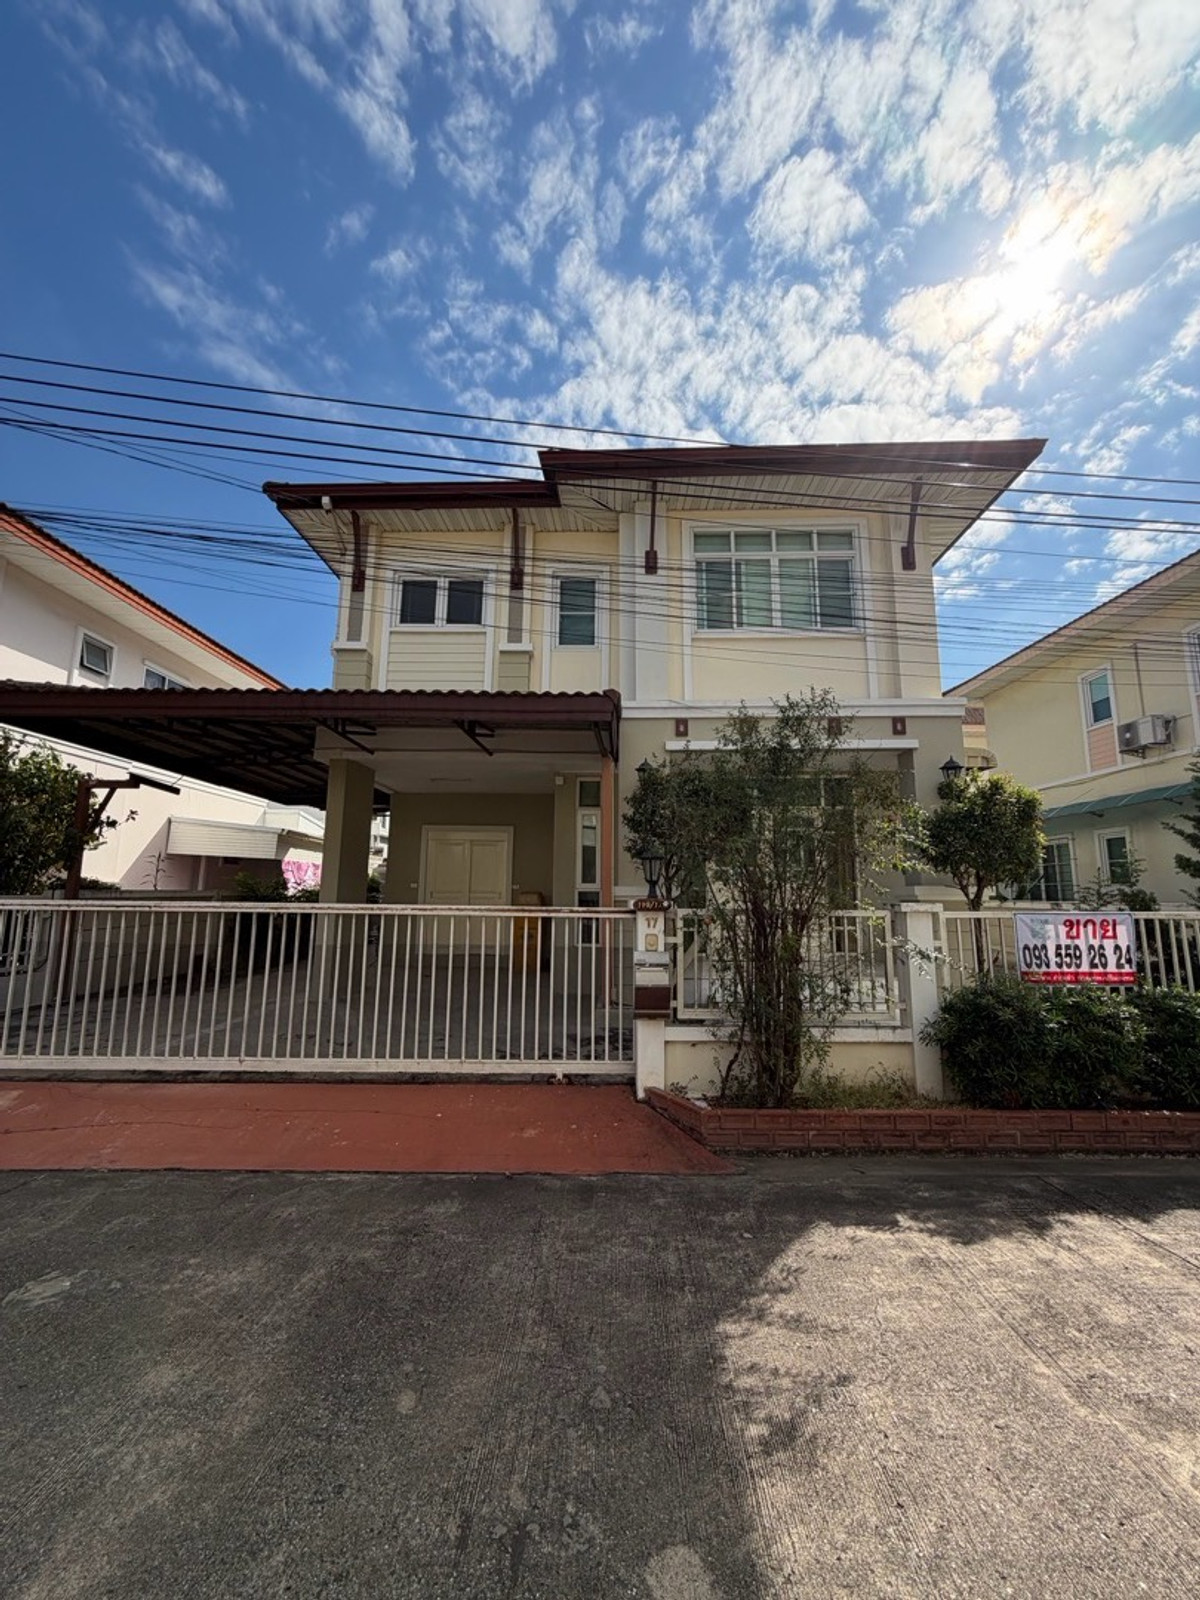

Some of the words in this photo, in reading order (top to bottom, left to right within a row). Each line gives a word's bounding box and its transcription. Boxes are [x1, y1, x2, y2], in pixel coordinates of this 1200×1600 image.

[645, 917, 659, 929] 17
[1063, 918, 1118, 940] ขาย
[1022, 943, 1050, 969] 093
[1054, 943, 1083, 969] 559
[1087, 943, 1108, 970] 26
[1113, 943, 1133, 970] 24
